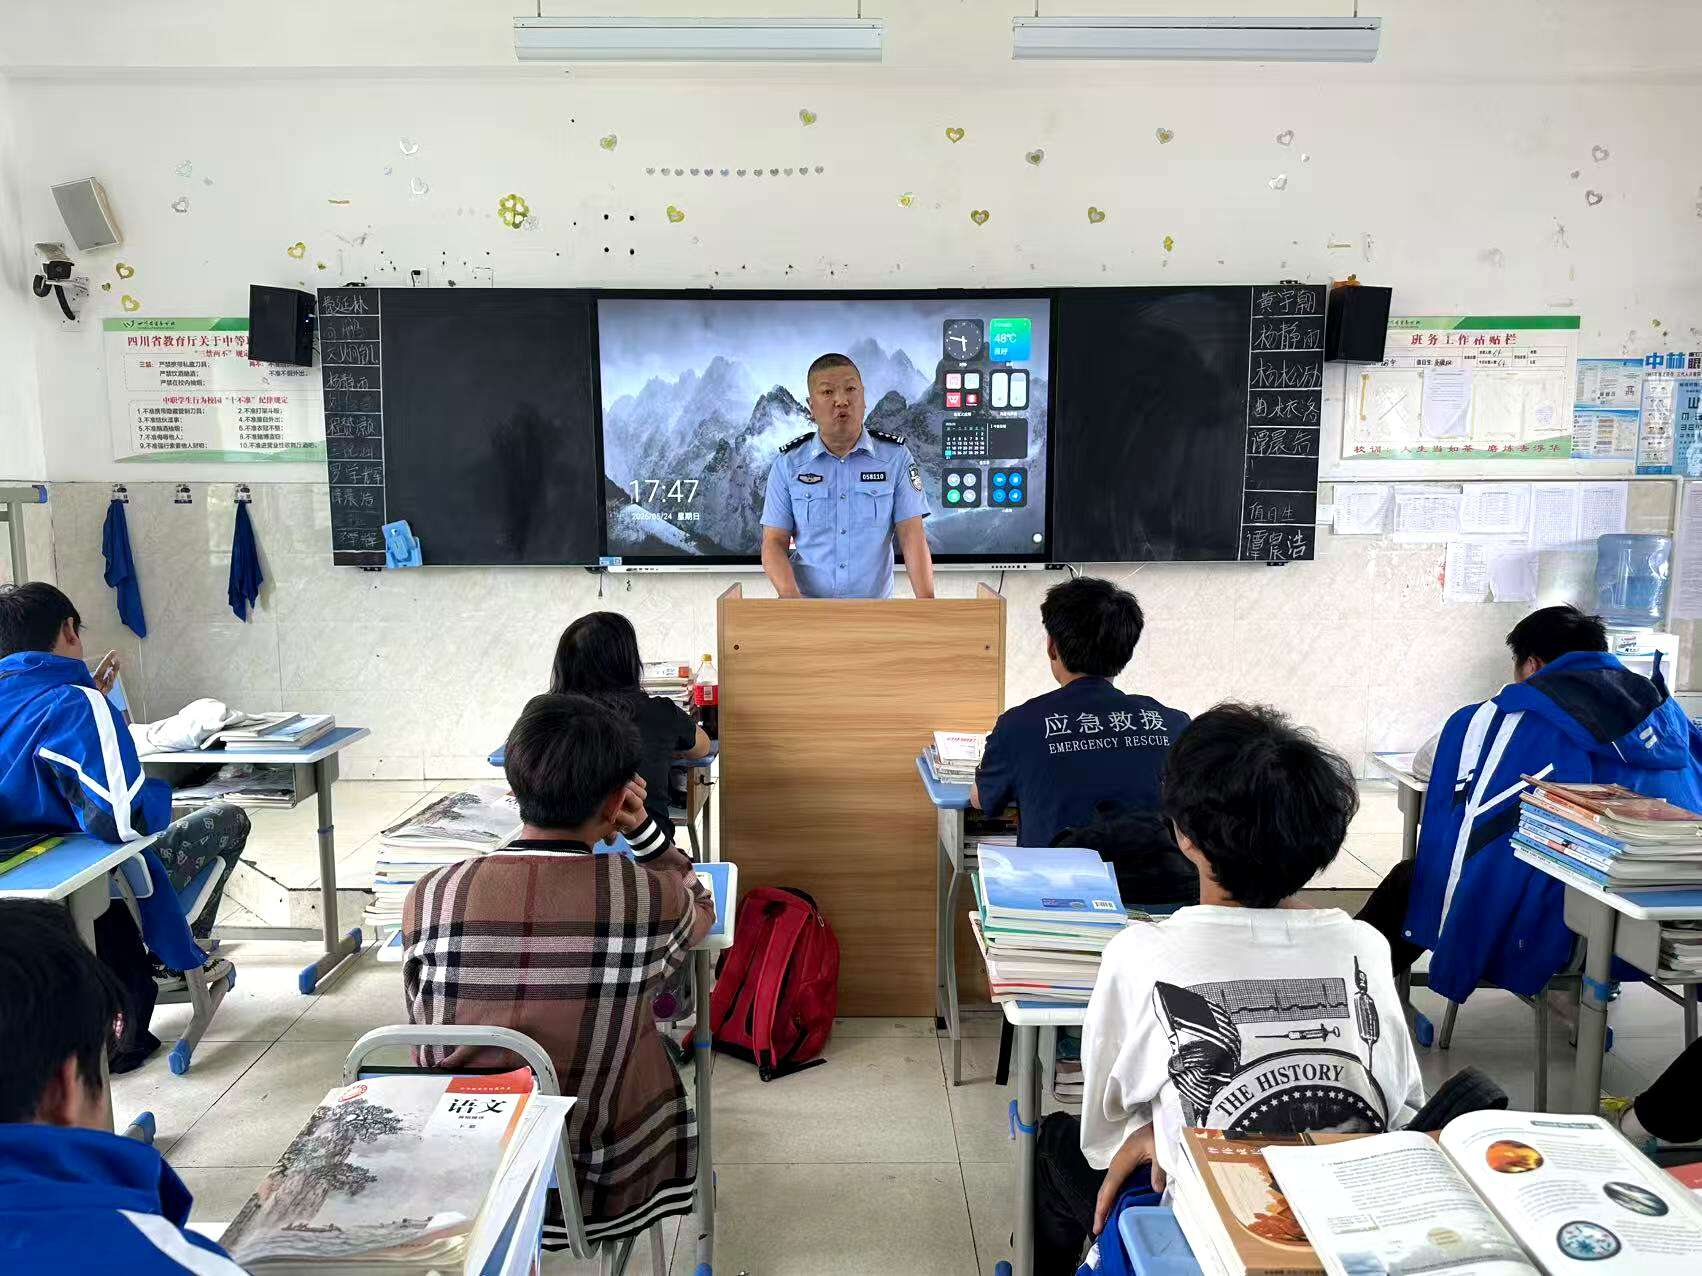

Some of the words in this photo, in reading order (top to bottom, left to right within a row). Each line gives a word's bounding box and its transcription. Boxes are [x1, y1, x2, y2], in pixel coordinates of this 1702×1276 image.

[127, 336, 250, 348] 四川省教育厅关于中等
[1410, 333, 1518, 346] 班务工作粘贴栏
[630, 480, 699, 503] 17:47
[677, 512, 700, 520] 星期日
[1249, 502, 1295, 521] 值日生
[1044, 708, 1168, 739] 应急救援
[1049, 737, 1119, 754] EMERGENCY
[1125, 735, 1170, 747] RESCUE
[1215, 1084, 1255, 1118] THE
[1255, 1063, 1345, 1093] HISTORY
[448, 1099, 507, 1113] 语文
